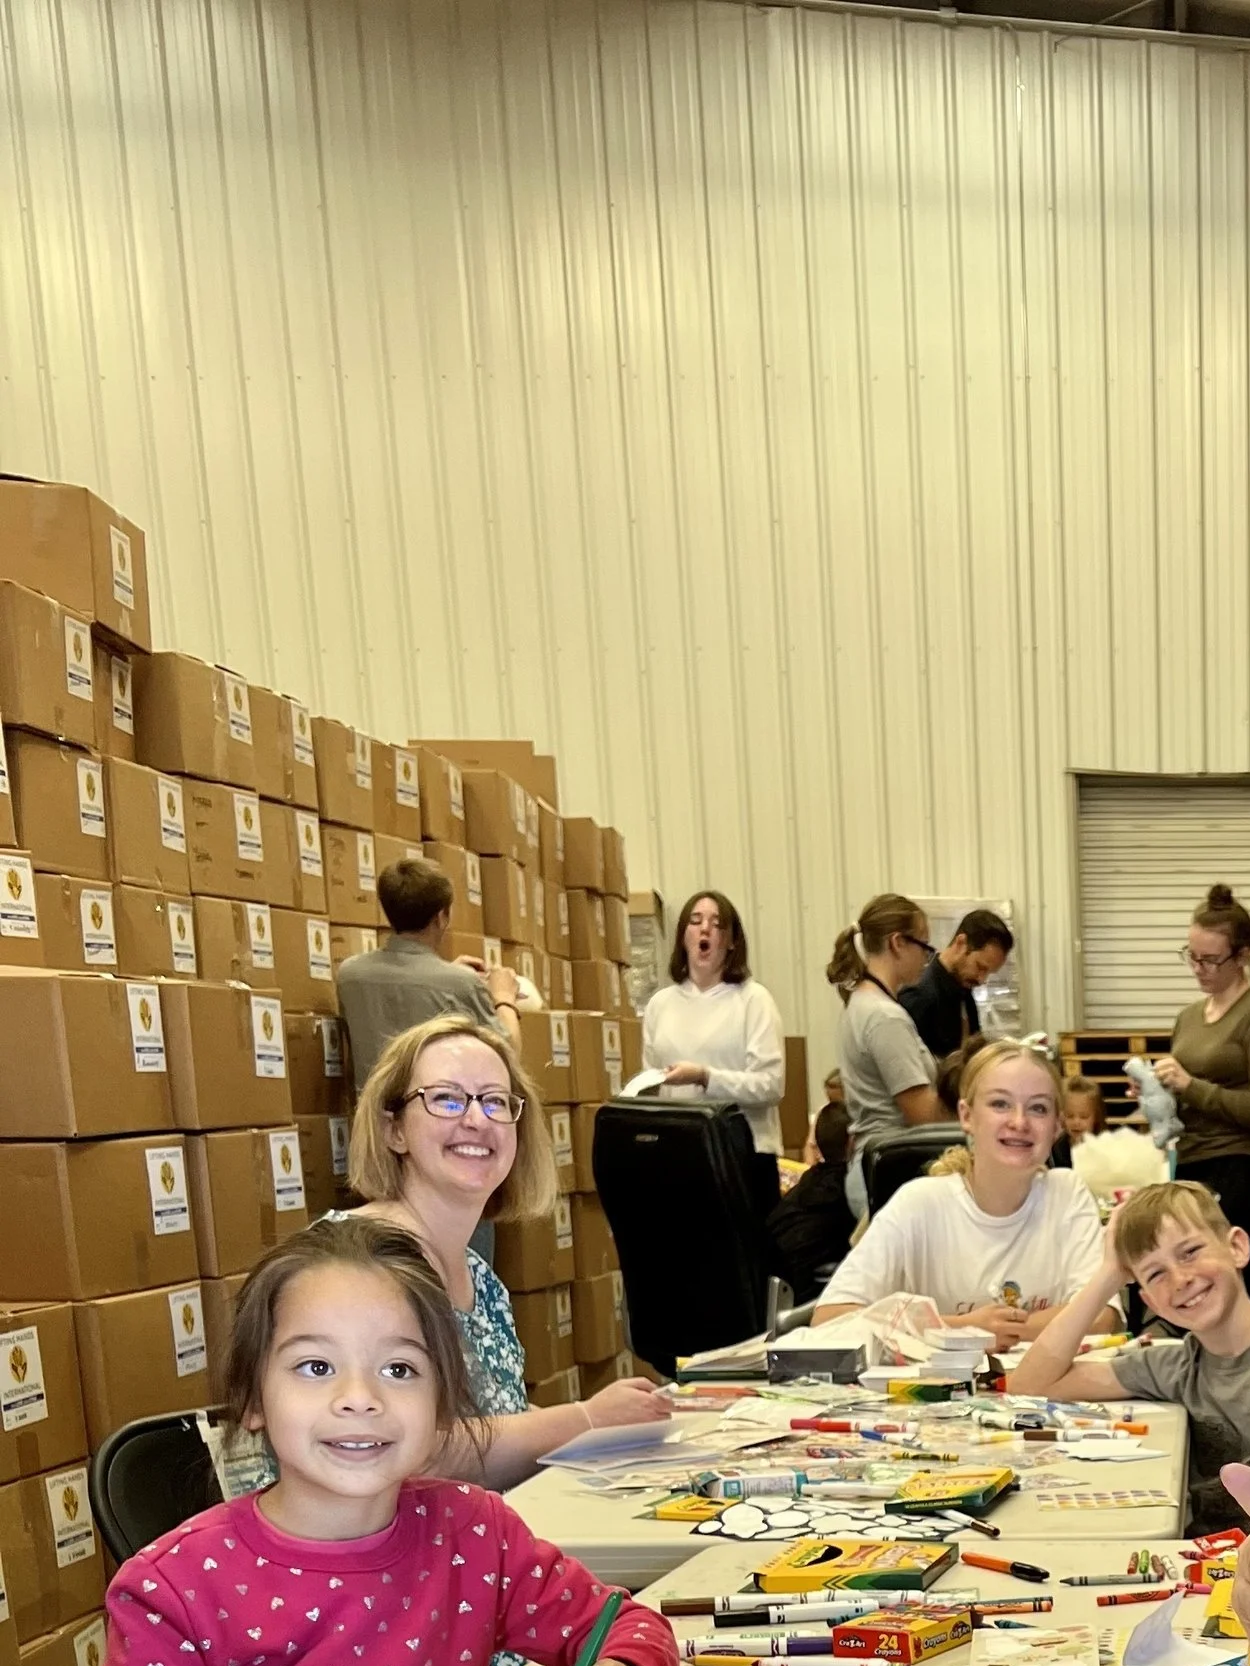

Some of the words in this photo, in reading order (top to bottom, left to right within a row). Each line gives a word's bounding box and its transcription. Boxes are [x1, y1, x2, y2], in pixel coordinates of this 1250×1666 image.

[878, 1633, 899, 1650] 24
[922, 1632, 948, 1650] Crayons
[874, 1648, 902, 1657] Crayons
